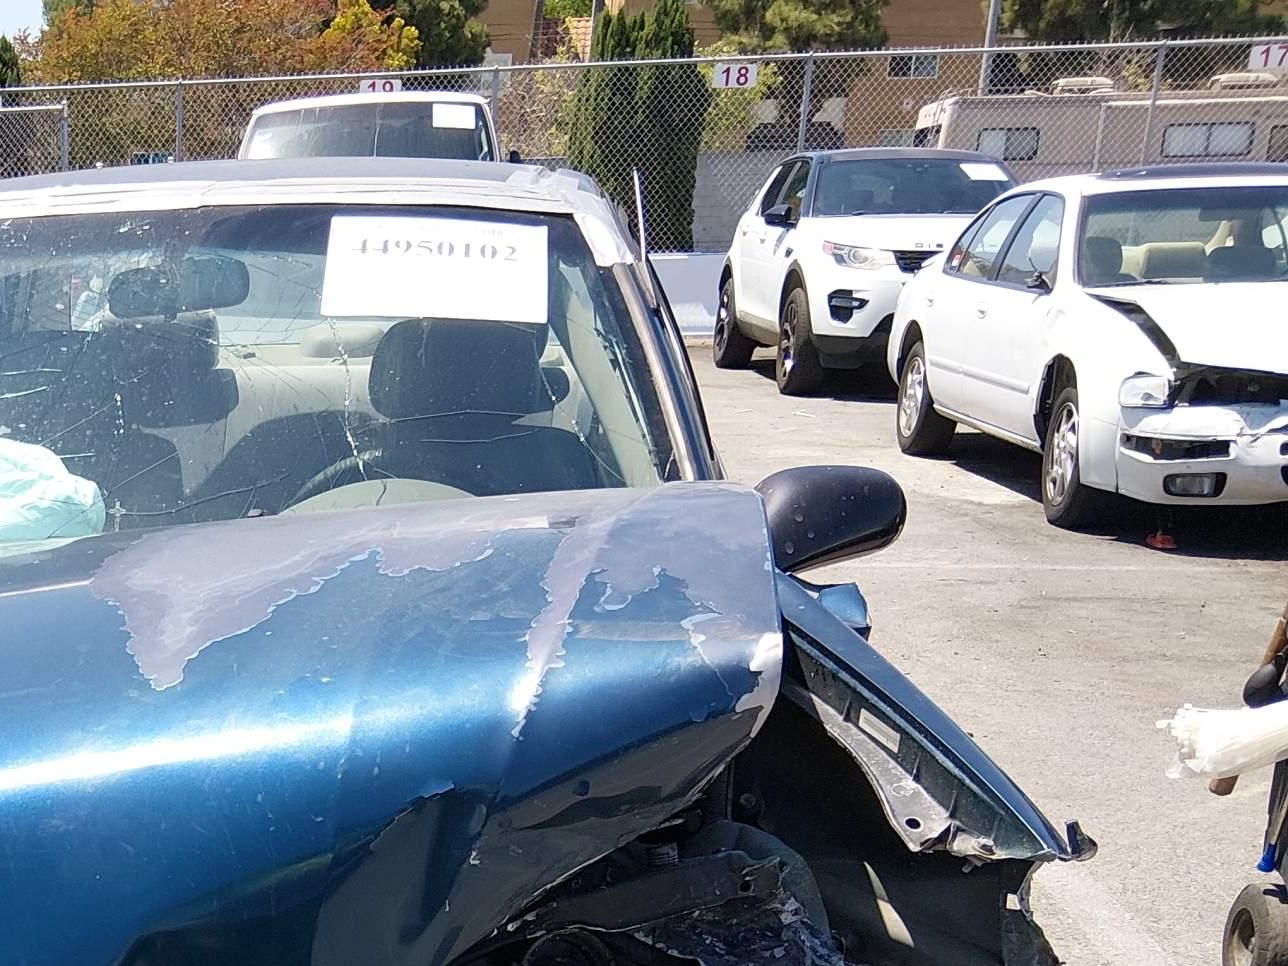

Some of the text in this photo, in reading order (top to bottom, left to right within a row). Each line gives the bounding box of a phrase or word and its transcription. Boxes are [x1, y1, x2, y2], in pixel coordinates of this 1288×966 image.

[1260, 44, 1288, 67] 17
[721, 65, 749, 86] 18
[351, 238, 519, 262] 44950102
